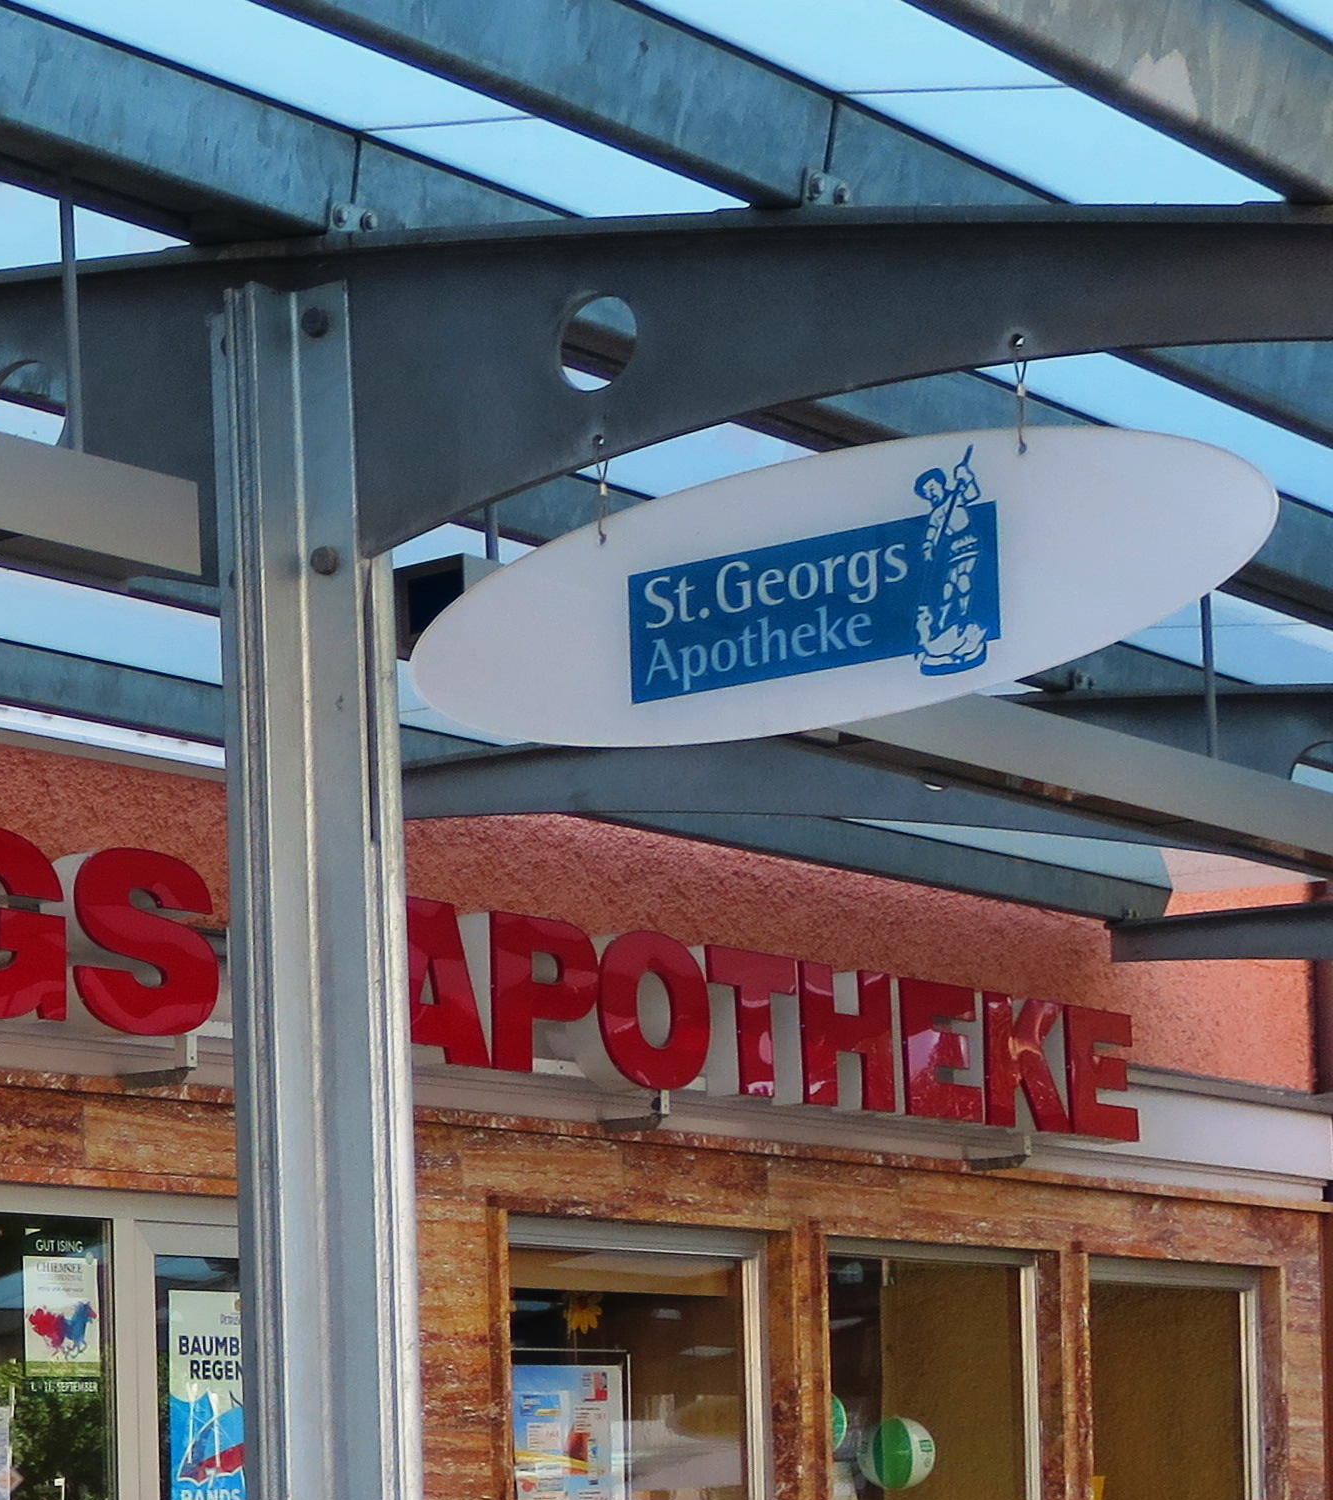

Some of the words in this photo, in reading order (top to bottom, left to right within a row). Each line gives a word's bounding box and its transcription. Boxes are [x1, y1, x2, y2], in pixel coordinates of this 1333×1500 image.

[644, 575, 709, 629] St.
[716, 543, 909, 613] Georgs
[645, 605, 873, 692] Apotheke
[35, 1239, 55, 1252] GUT
[57, 1240, 83, 1253] ISING
[56, 1381, 99, 1393] SEPTEMBER
